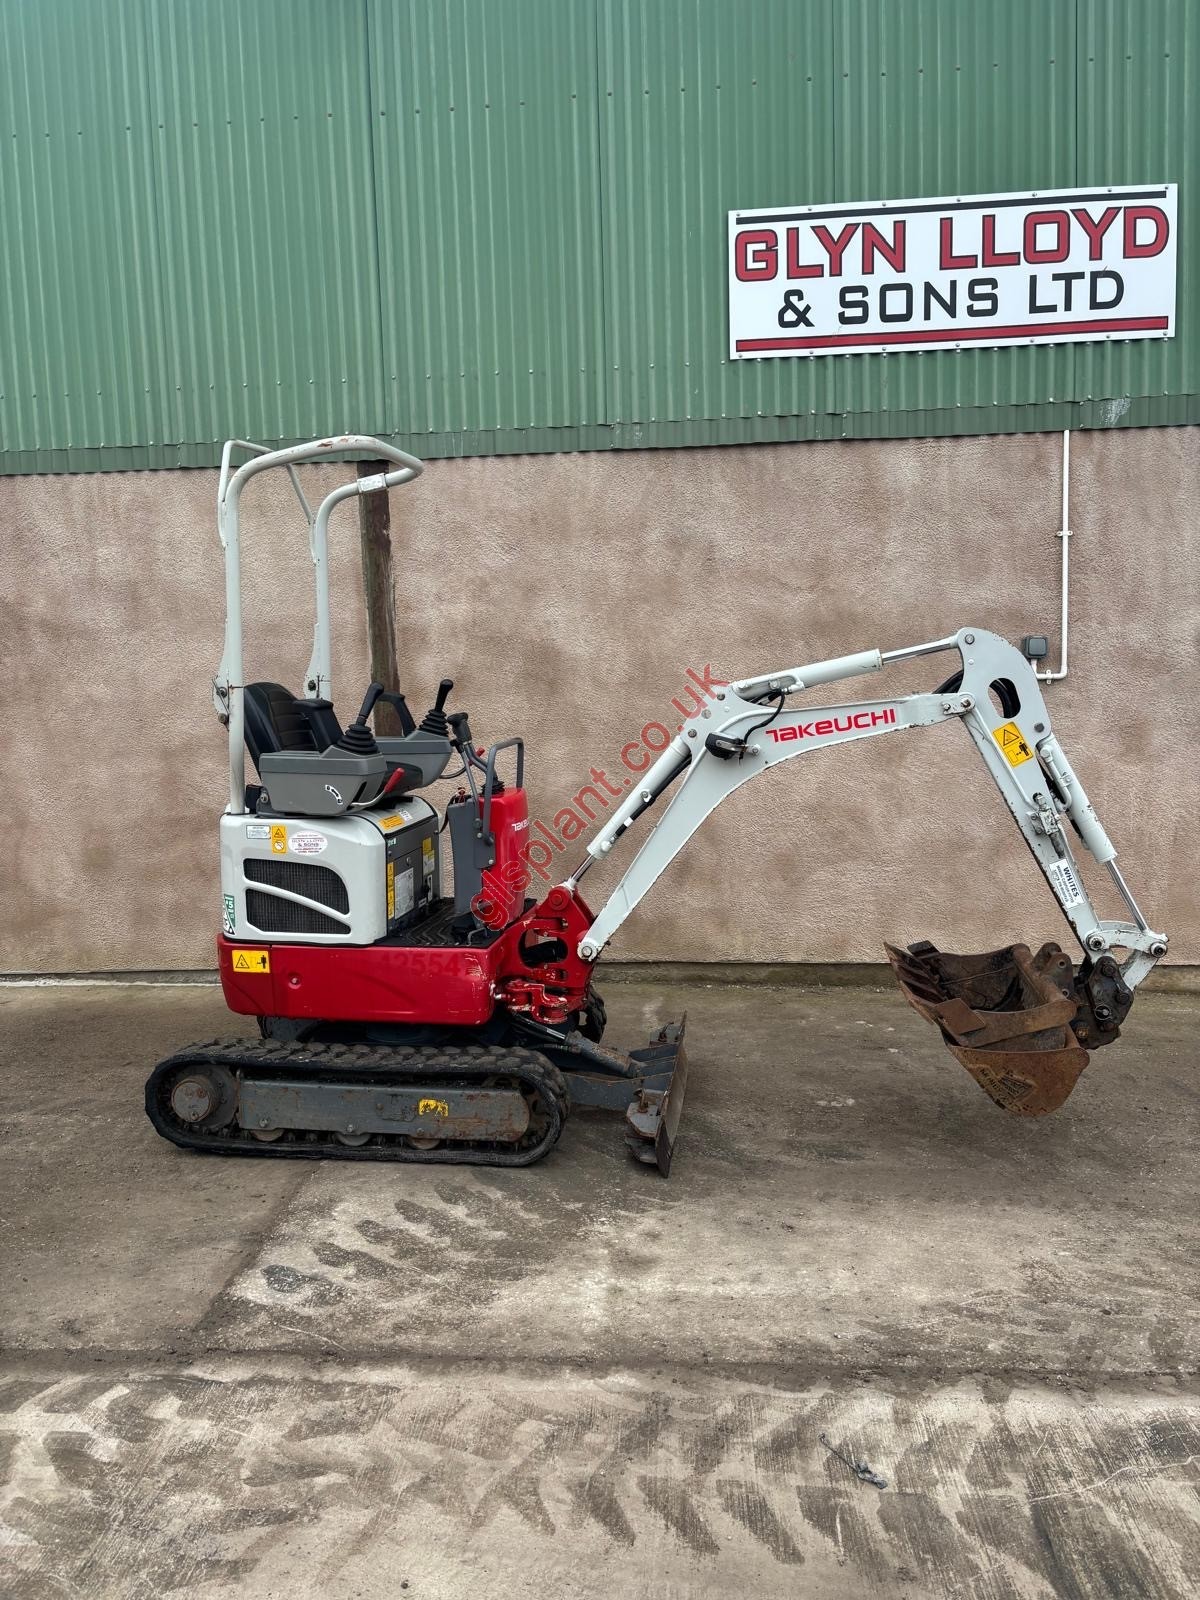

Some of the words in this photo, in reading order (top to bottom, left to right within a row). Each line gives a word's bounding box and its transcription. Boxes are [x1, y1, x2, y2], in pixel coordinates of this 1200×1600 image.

[735, 220, 906, 282] GLYN
[939, 205, 1170, 270] LLOYD
[777, 289, 815, 328] &
[838, 277, 999, 325] SONS
[1029, 270, 1125, 314] LTD
[1063, 866, 1080, 898] WHITES
